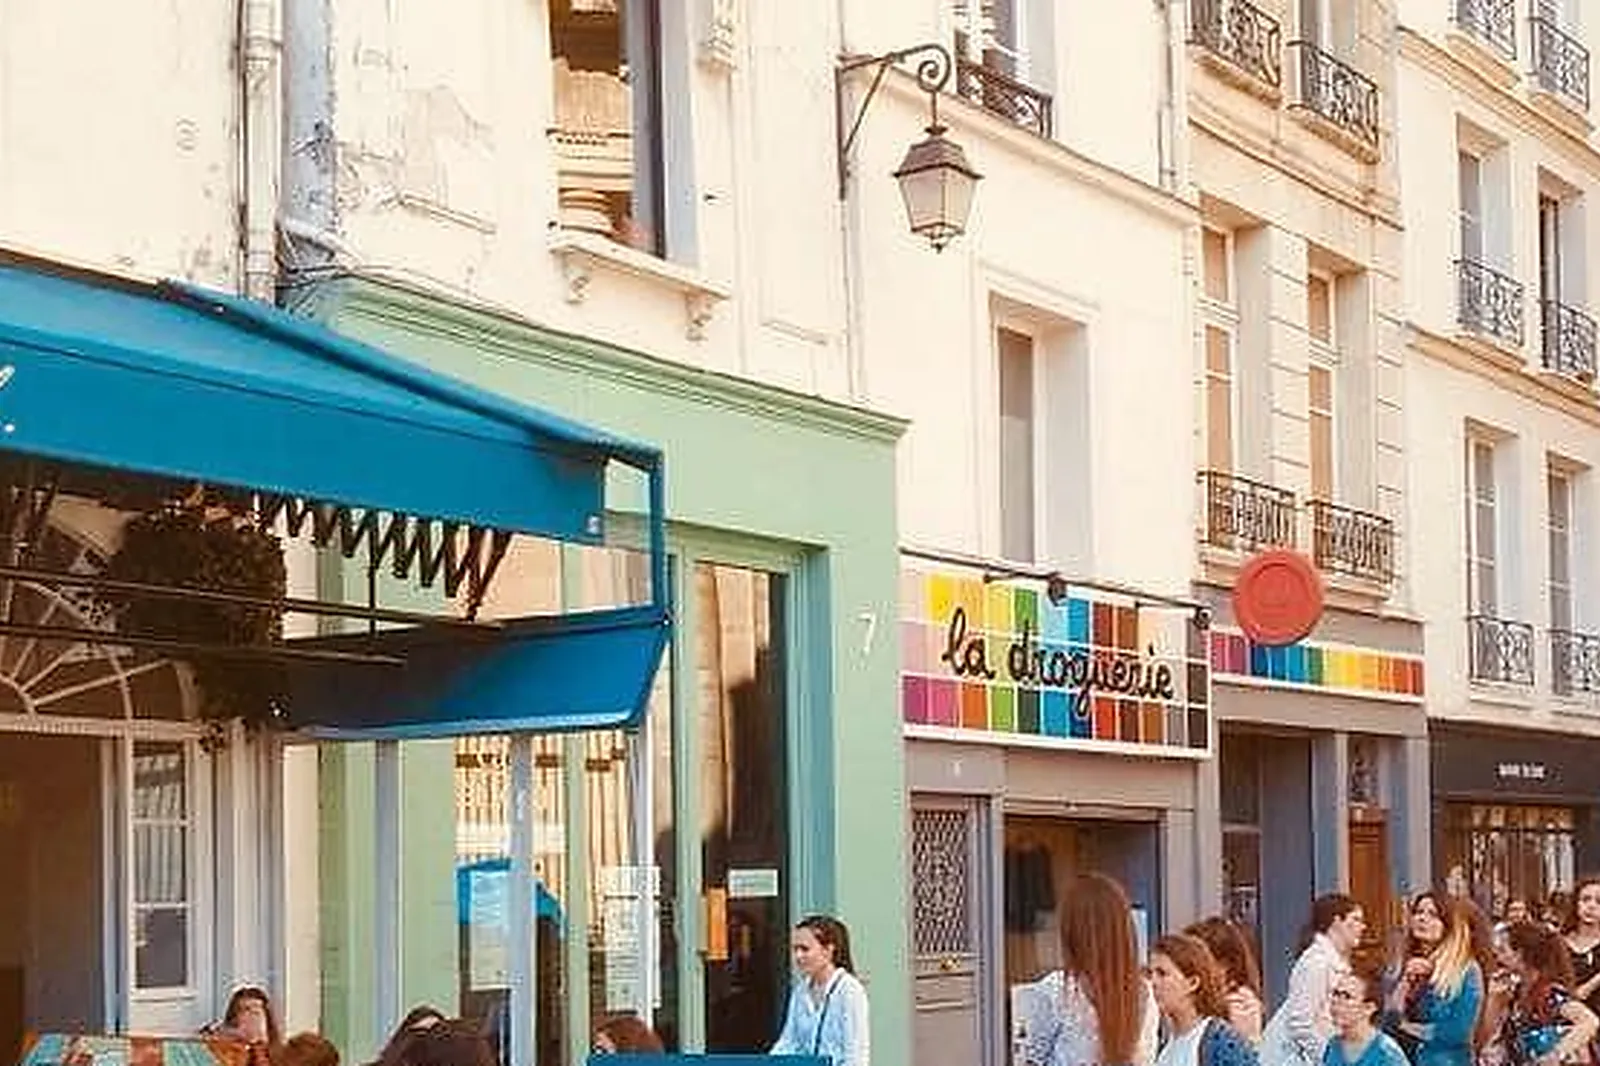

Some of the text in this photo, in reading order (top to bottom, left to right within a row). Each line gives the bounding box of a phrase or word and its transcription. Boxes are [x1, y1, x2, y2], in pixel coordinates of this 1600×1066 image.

[859, 612, 877, 656] 7
[942, 607, 1174, 717] la droguerie
